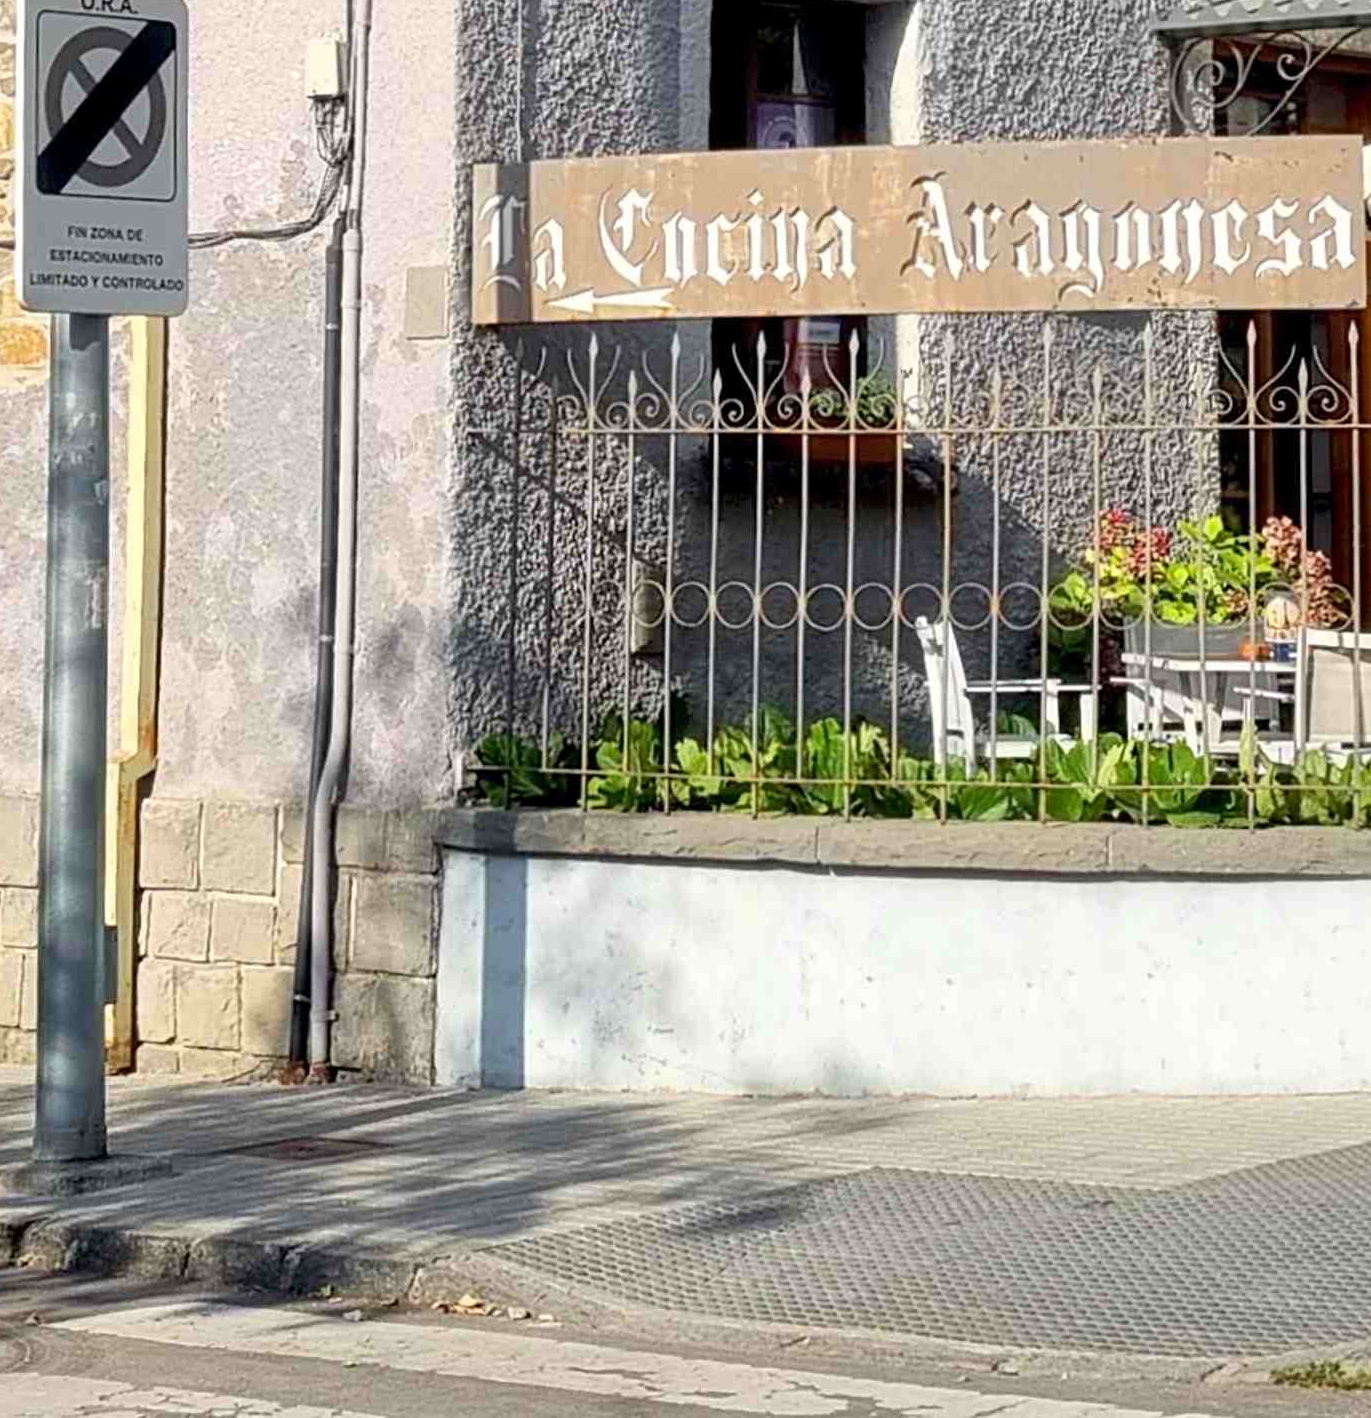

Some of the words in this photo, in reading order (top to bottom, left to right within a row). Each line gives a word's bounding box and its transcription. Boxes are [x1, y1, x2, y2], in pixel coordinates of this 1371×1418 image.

[67, 225, 87, 238] FIN
[90, 227, 124, 241] ZONA
[127, 228, 144, 242] DE
[478, 194, 568, 291] La
[598, 183, 858, 293] Cocina
[900, 171, 1358, 300] Aragonesa
[50, 249, 165, 267] ESTACIONAMIENTO
[30, 272, 89, 288] LIMITADO
[91, 274, 100, 288] Y
[102, 275, 185, 292] CONTROLADO
